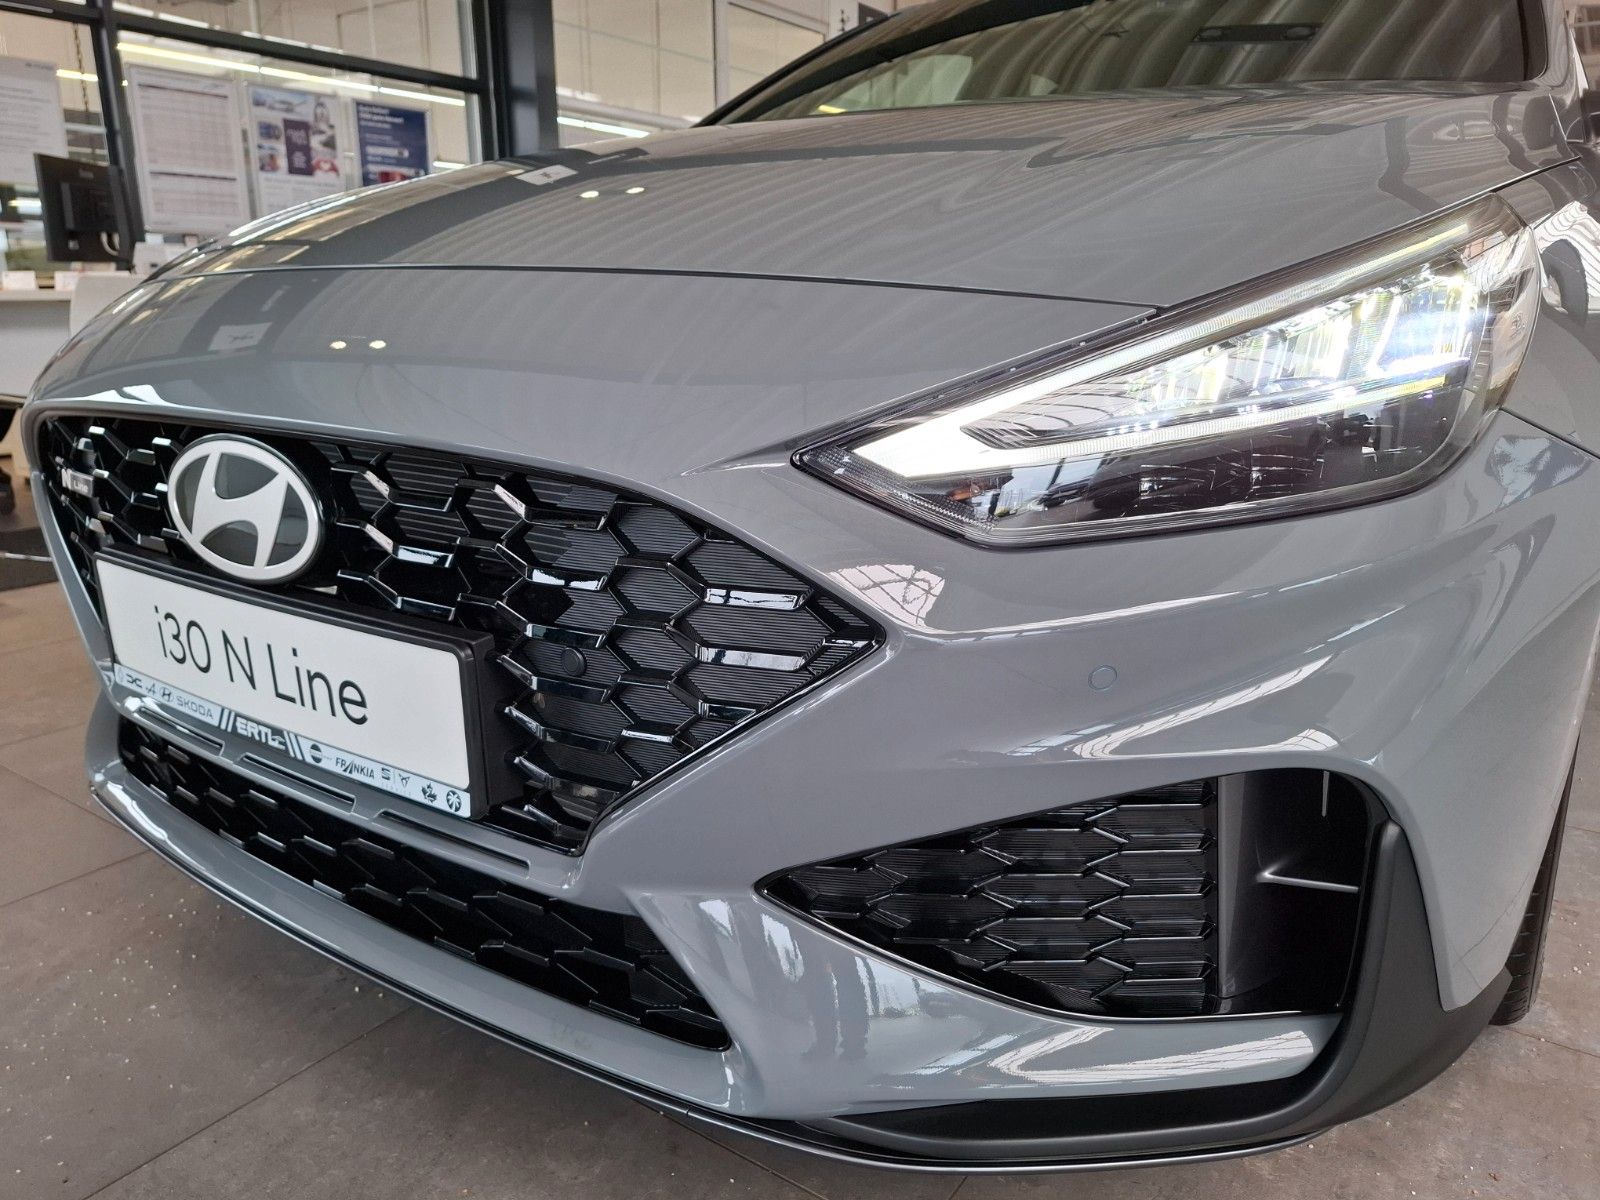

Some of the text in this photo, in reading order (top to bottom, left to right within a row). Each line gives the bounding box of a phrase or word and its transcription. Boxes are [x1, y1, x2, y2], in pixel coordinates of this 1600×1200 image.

[154, 605, 369, 726] i30 N Line
[335, 756, 375, 780] FRANKIA
